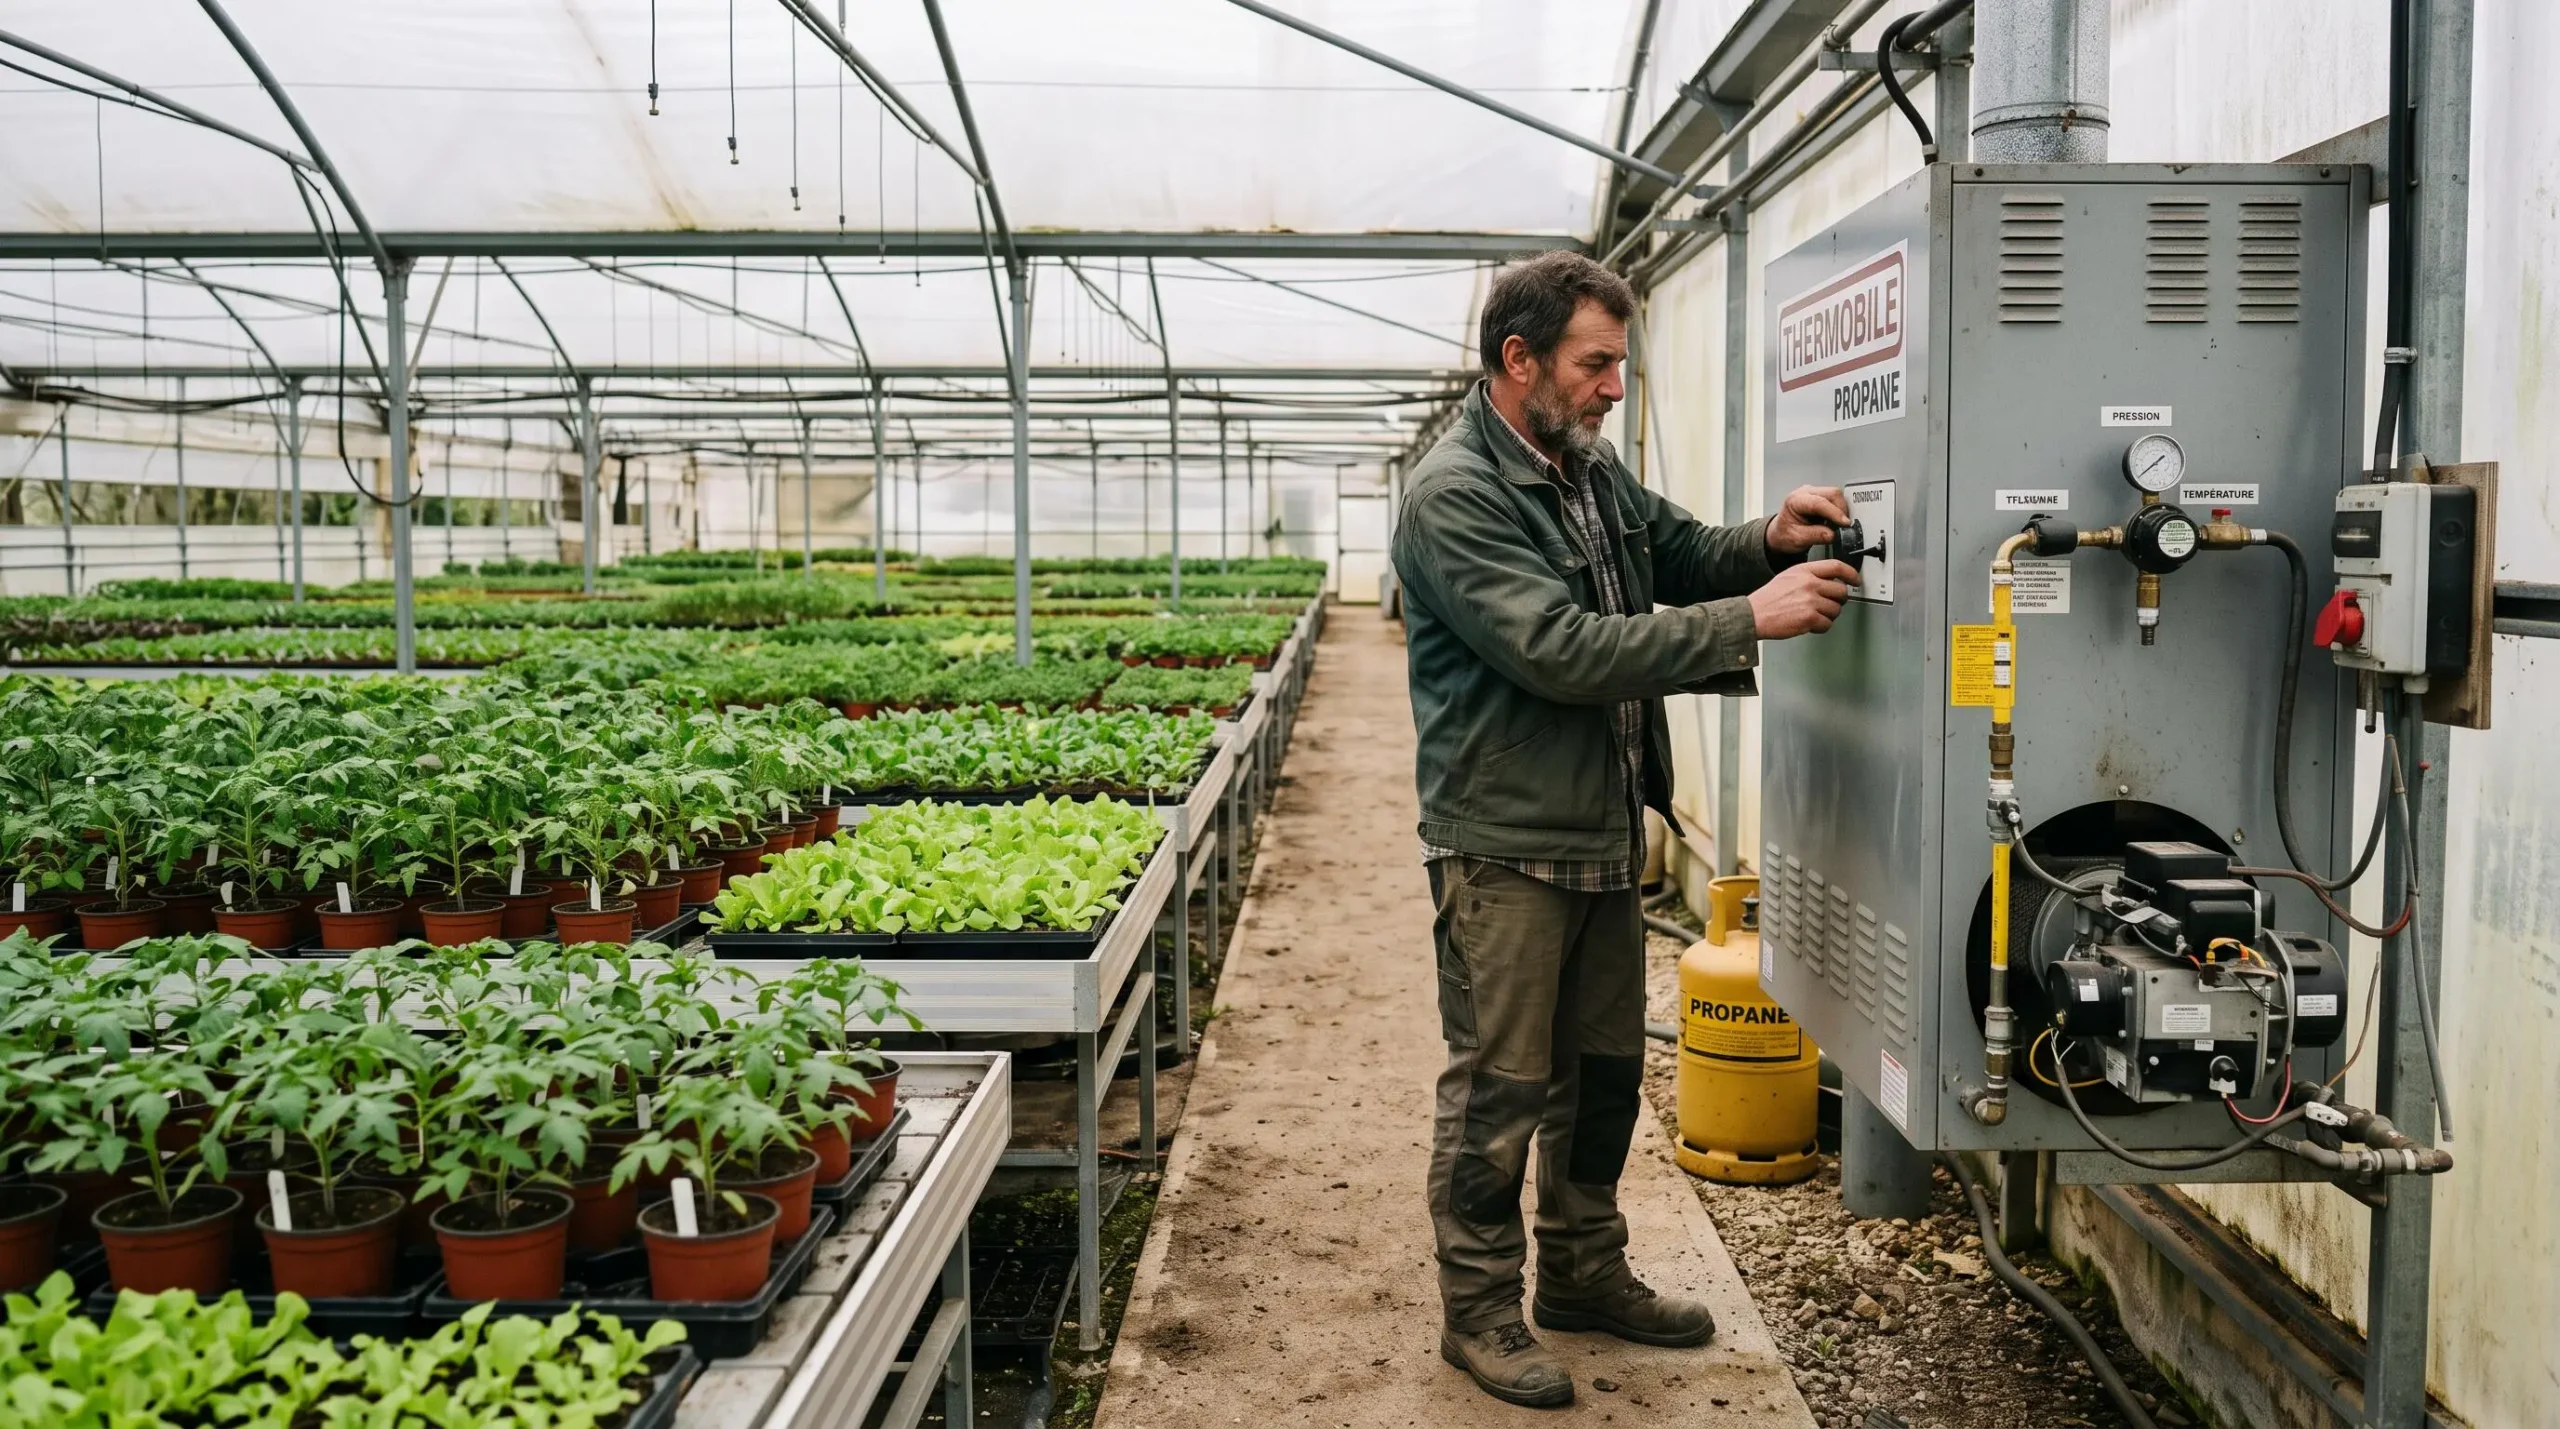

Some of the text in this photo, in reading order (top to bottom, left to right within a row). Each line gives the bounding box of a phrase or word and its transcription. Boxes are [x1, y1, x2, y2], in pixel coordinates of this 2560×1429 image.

[1783, 277, 1898, 372] THERMOBILE
[1834, 370, 1901, 422] PROPANE
[2112, 412, 2160, 421] PRESSION
[2183, 488, 2255, 499] TEMPÉRATURE
